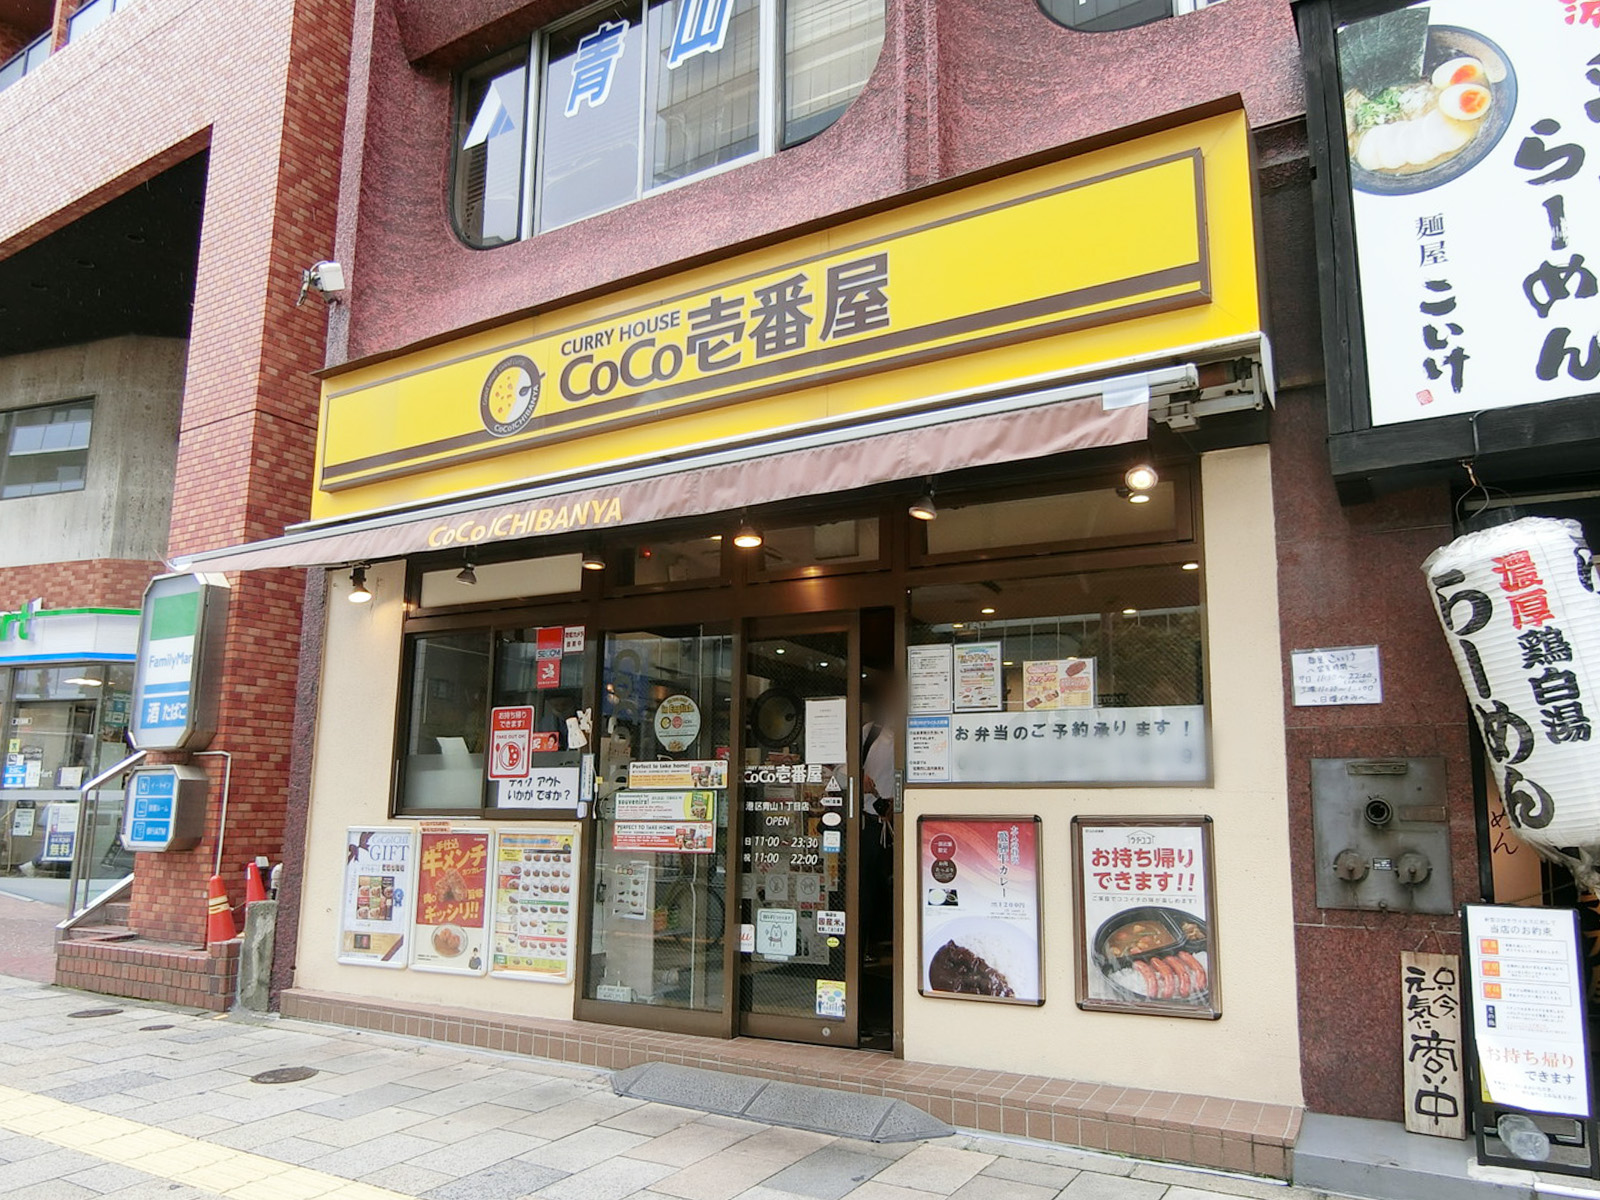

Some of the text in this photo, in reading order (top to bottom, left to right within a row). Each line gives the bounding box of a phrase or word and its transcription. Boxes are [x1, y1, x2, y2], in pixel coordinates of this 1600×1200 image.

[564, 0, 733, 118] 青山
[1415, 212, 1449, 267] 麺屋
[1514, 118, 1600, 381] らーめん
[559, 252, 889, 402] CoCo壱番屋
[561, 311, 681, 356] CURRY HOUSE
[538, 648, 561, 659] SECOM
[1431, 568, 1556, 830] らーめん
[147, 702, 188, 723] 酒 たばこ
[498, 711, 527, 720] お持ち帰り
[670, 703, 695, 715] English
[537, 776, 562, 787] アウト
[744, 764, 823, 783] CoCo壱番屋
[507, 789, 533, 801] いかが
[765, 816, 790, 826] OPEN
[369, 844, 410, 862] GIFT
[422, 843, 487, 878] 牛メンチ
[790, 854, 818, 865] 22:00
[1092, 847, 1193, 869] お持ち帰り
[1490, 924, 1553, 936] 当店のお約束
[1487, 1047, 1574, 1069] お持ち帰り
[1525, 1071, 1575, 1085] できます
